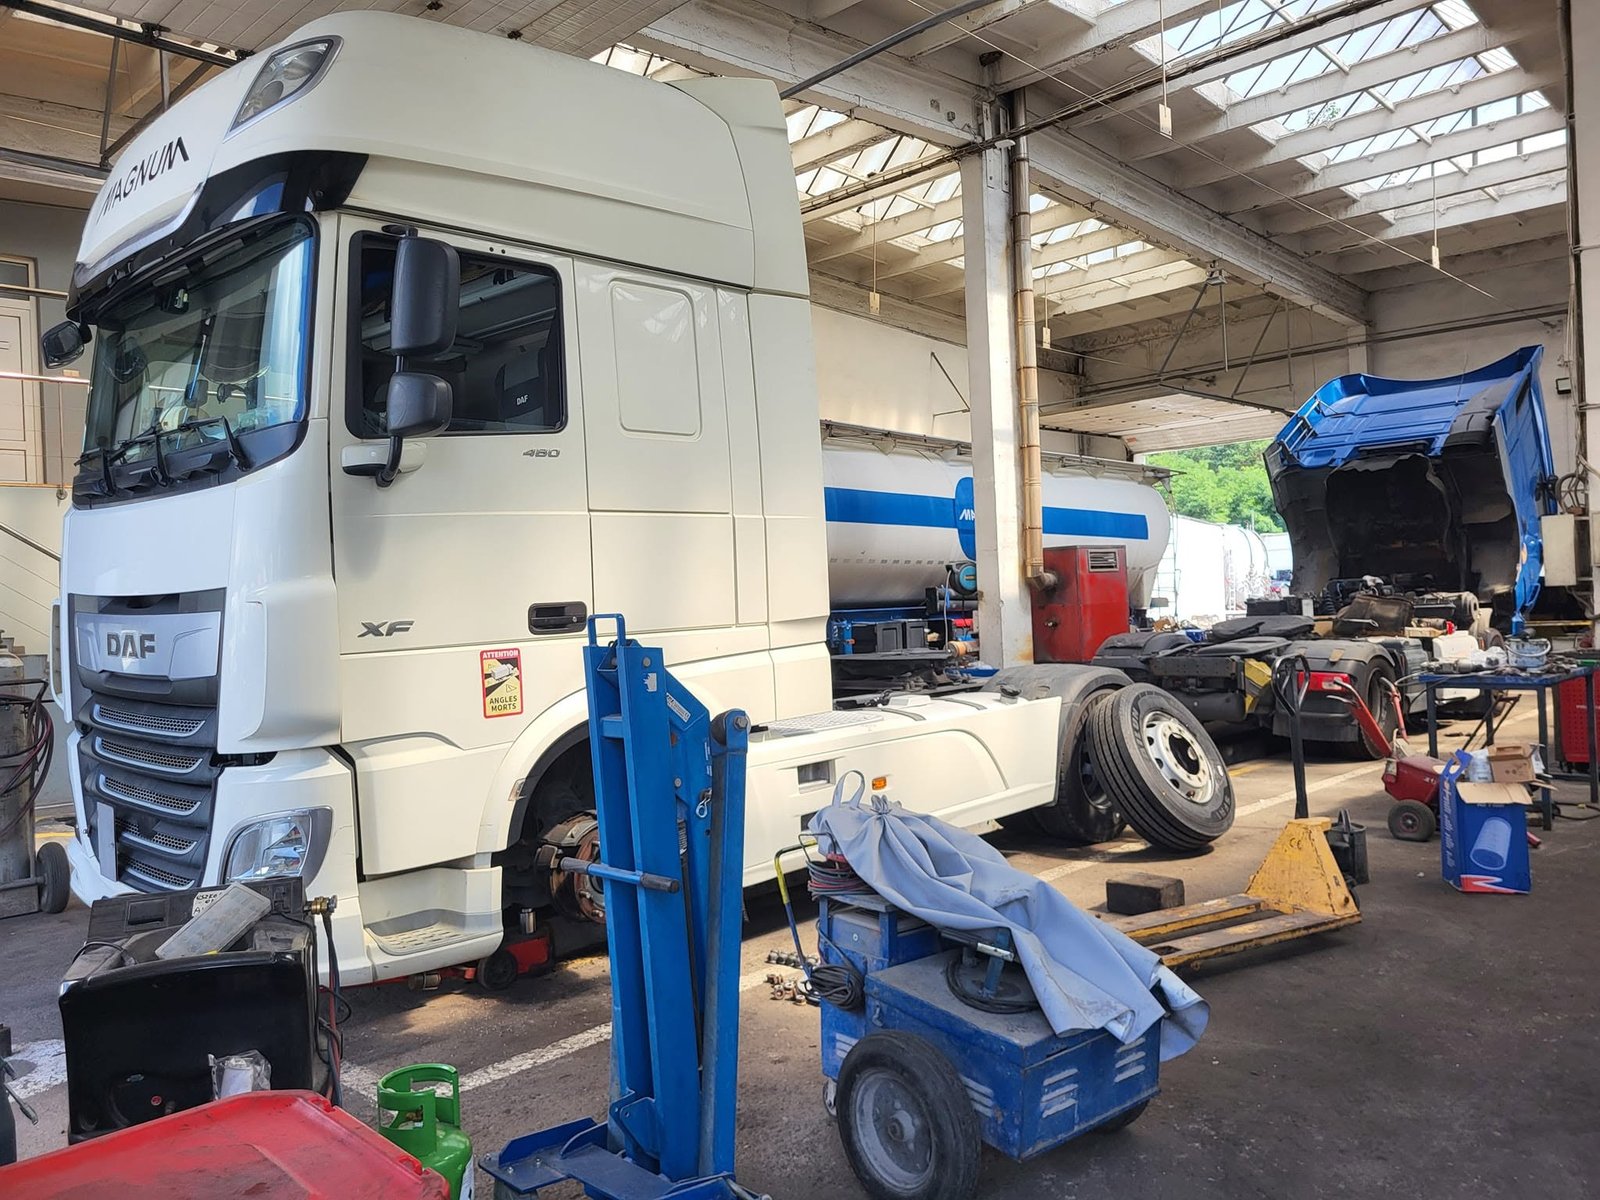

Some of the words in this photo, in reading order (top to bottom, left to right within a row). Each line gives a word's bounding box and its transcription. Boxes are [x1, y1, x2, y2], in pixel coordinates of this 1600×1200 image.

[96, 136, 190, 223] MAGNUM
[516, 394, 529, 406] DAF
[357, 620, 415, 638] XF
[107, 632, 156, 659] DAF
[482, 650, 519, 659] ATTENTION
[489, 695, 518, 705] ANGLES
[491, 703, 517, 712] MORTS
